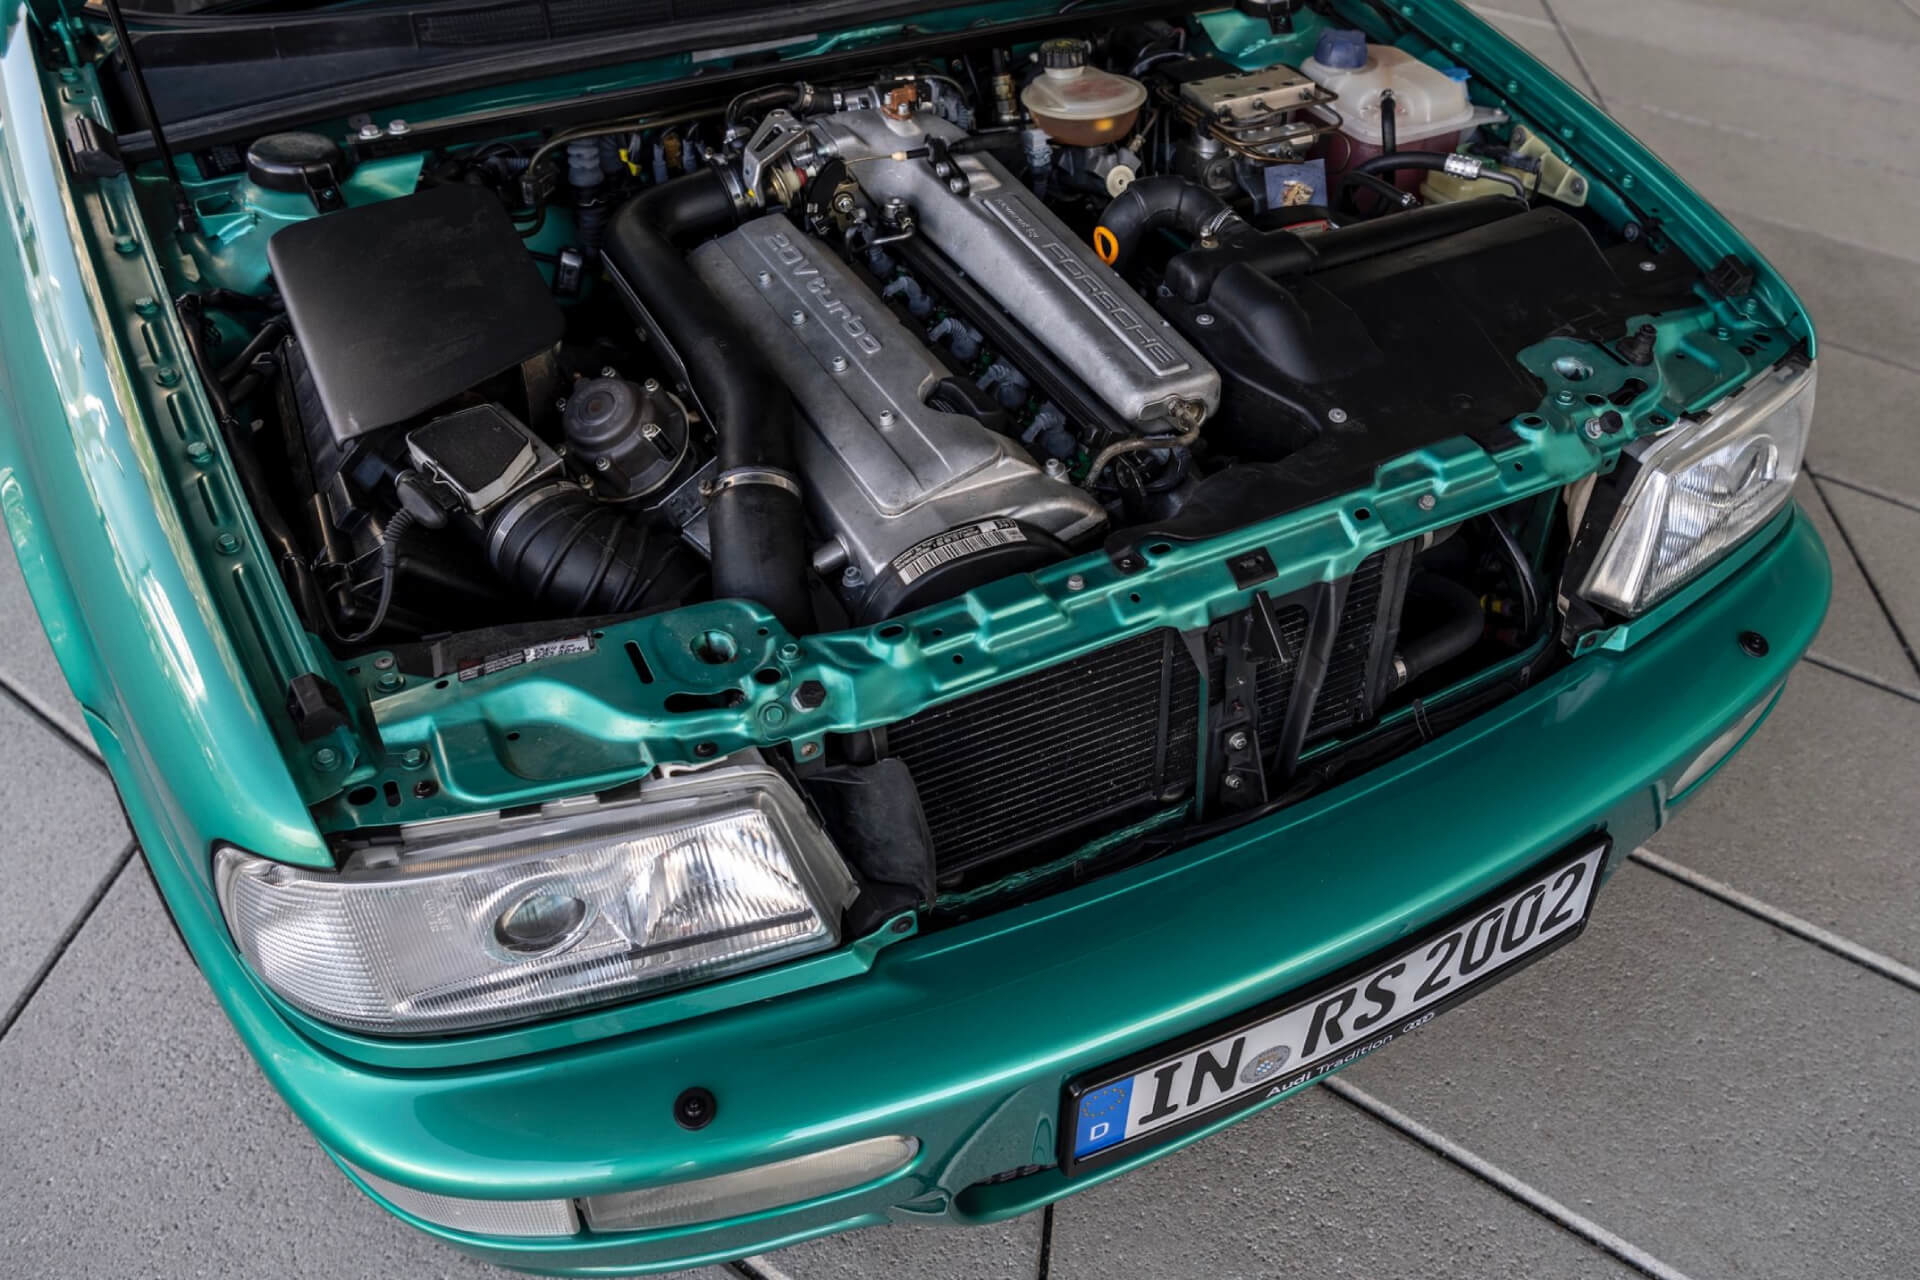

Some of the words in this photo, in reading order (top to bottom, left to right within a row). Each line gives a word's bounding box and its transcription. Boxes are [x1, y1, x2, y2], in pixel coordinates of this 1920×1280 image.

[763, 231, 819, 275] 20V
[806, 276, 882, 354] turbo
[1041, 242, 1176, 363] PORSCHE
[1138, 1036, 1246, 1125] IN
[1301, 963, 1406, 1058] RS
[1413, 862, 1587, 1002] 2002
[1266, 1071, 1311, 1097] Audi
[1316, 1034, 1394, 1074] Tradition
[1089, 1122, 1110, 1142] D
